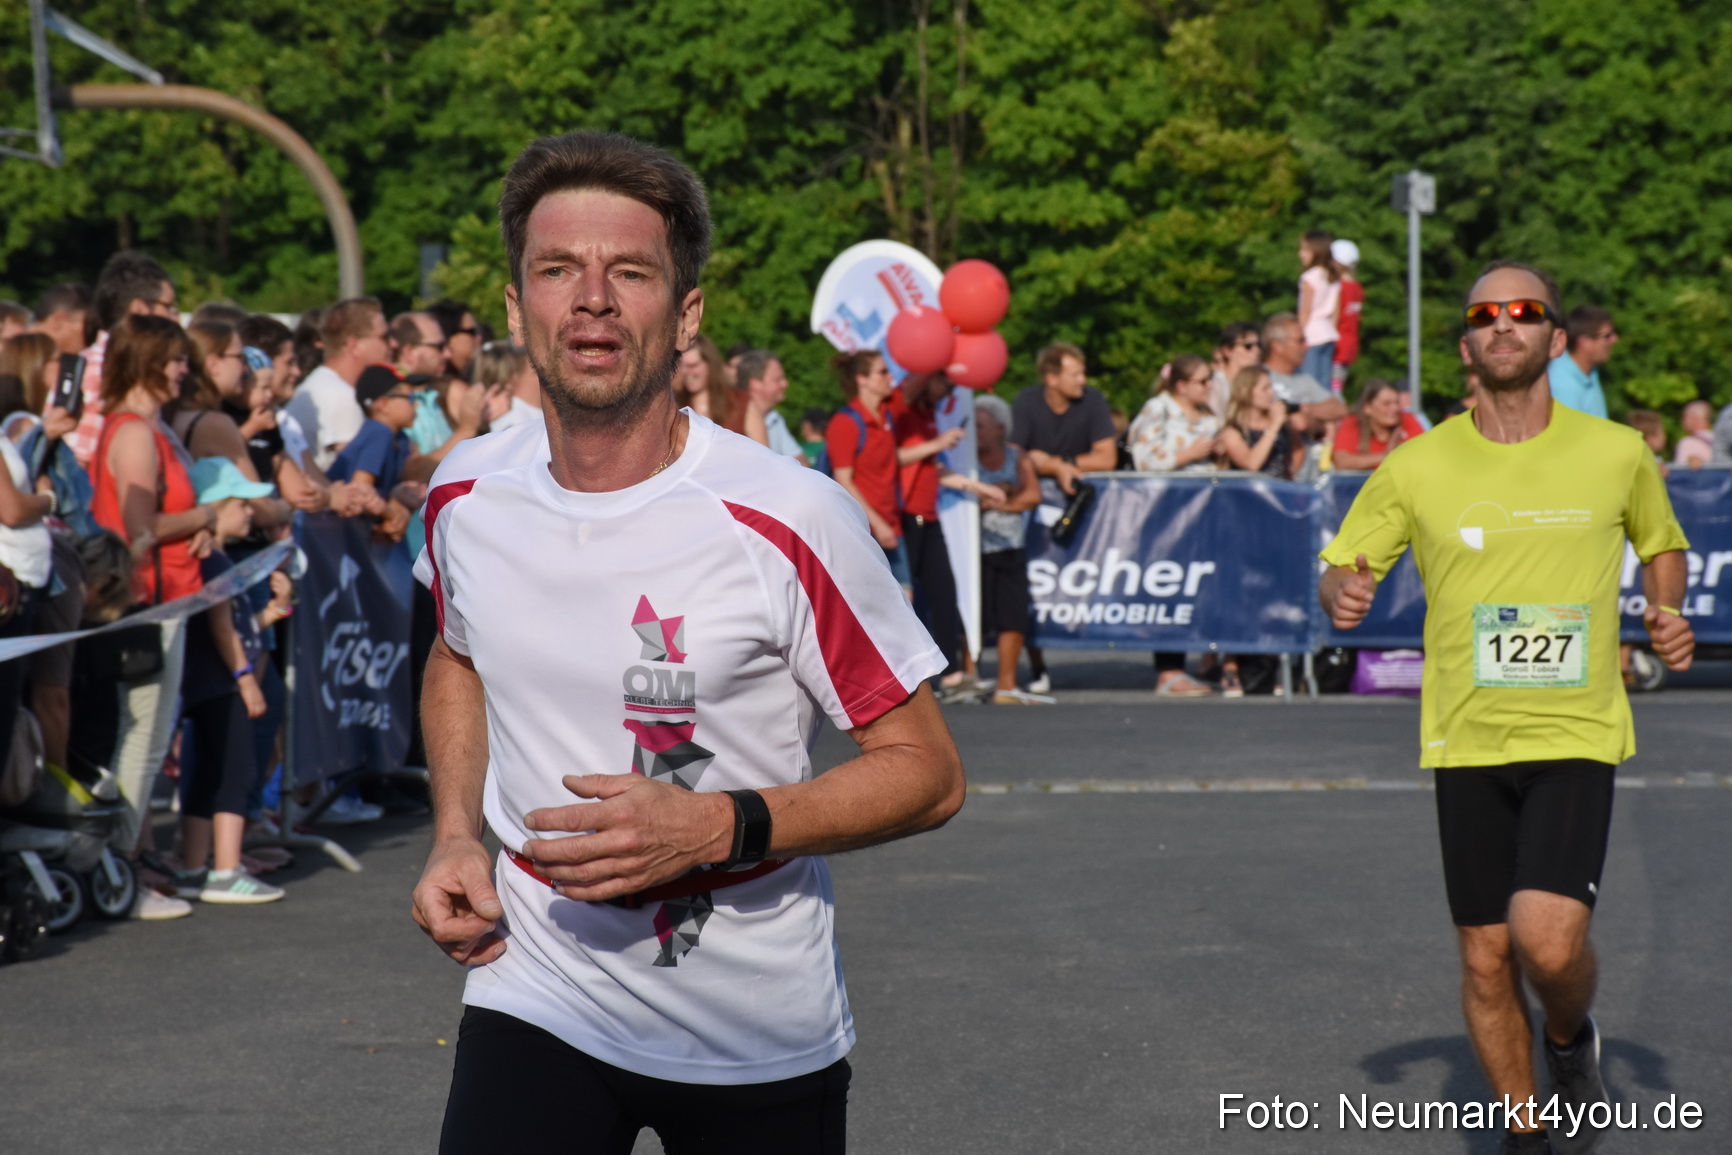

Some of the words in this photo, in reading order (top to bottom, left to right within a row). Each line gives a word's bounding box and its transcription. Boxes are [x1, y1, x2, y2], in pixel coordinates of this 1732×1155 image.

[1031, 603, 1194, 625] TOMOBILE
[1488, 633, 1574, 663] 1227
[1531, 664, 1561, 673] Tobias
[653, 698, 695, 708] TECHNIK
